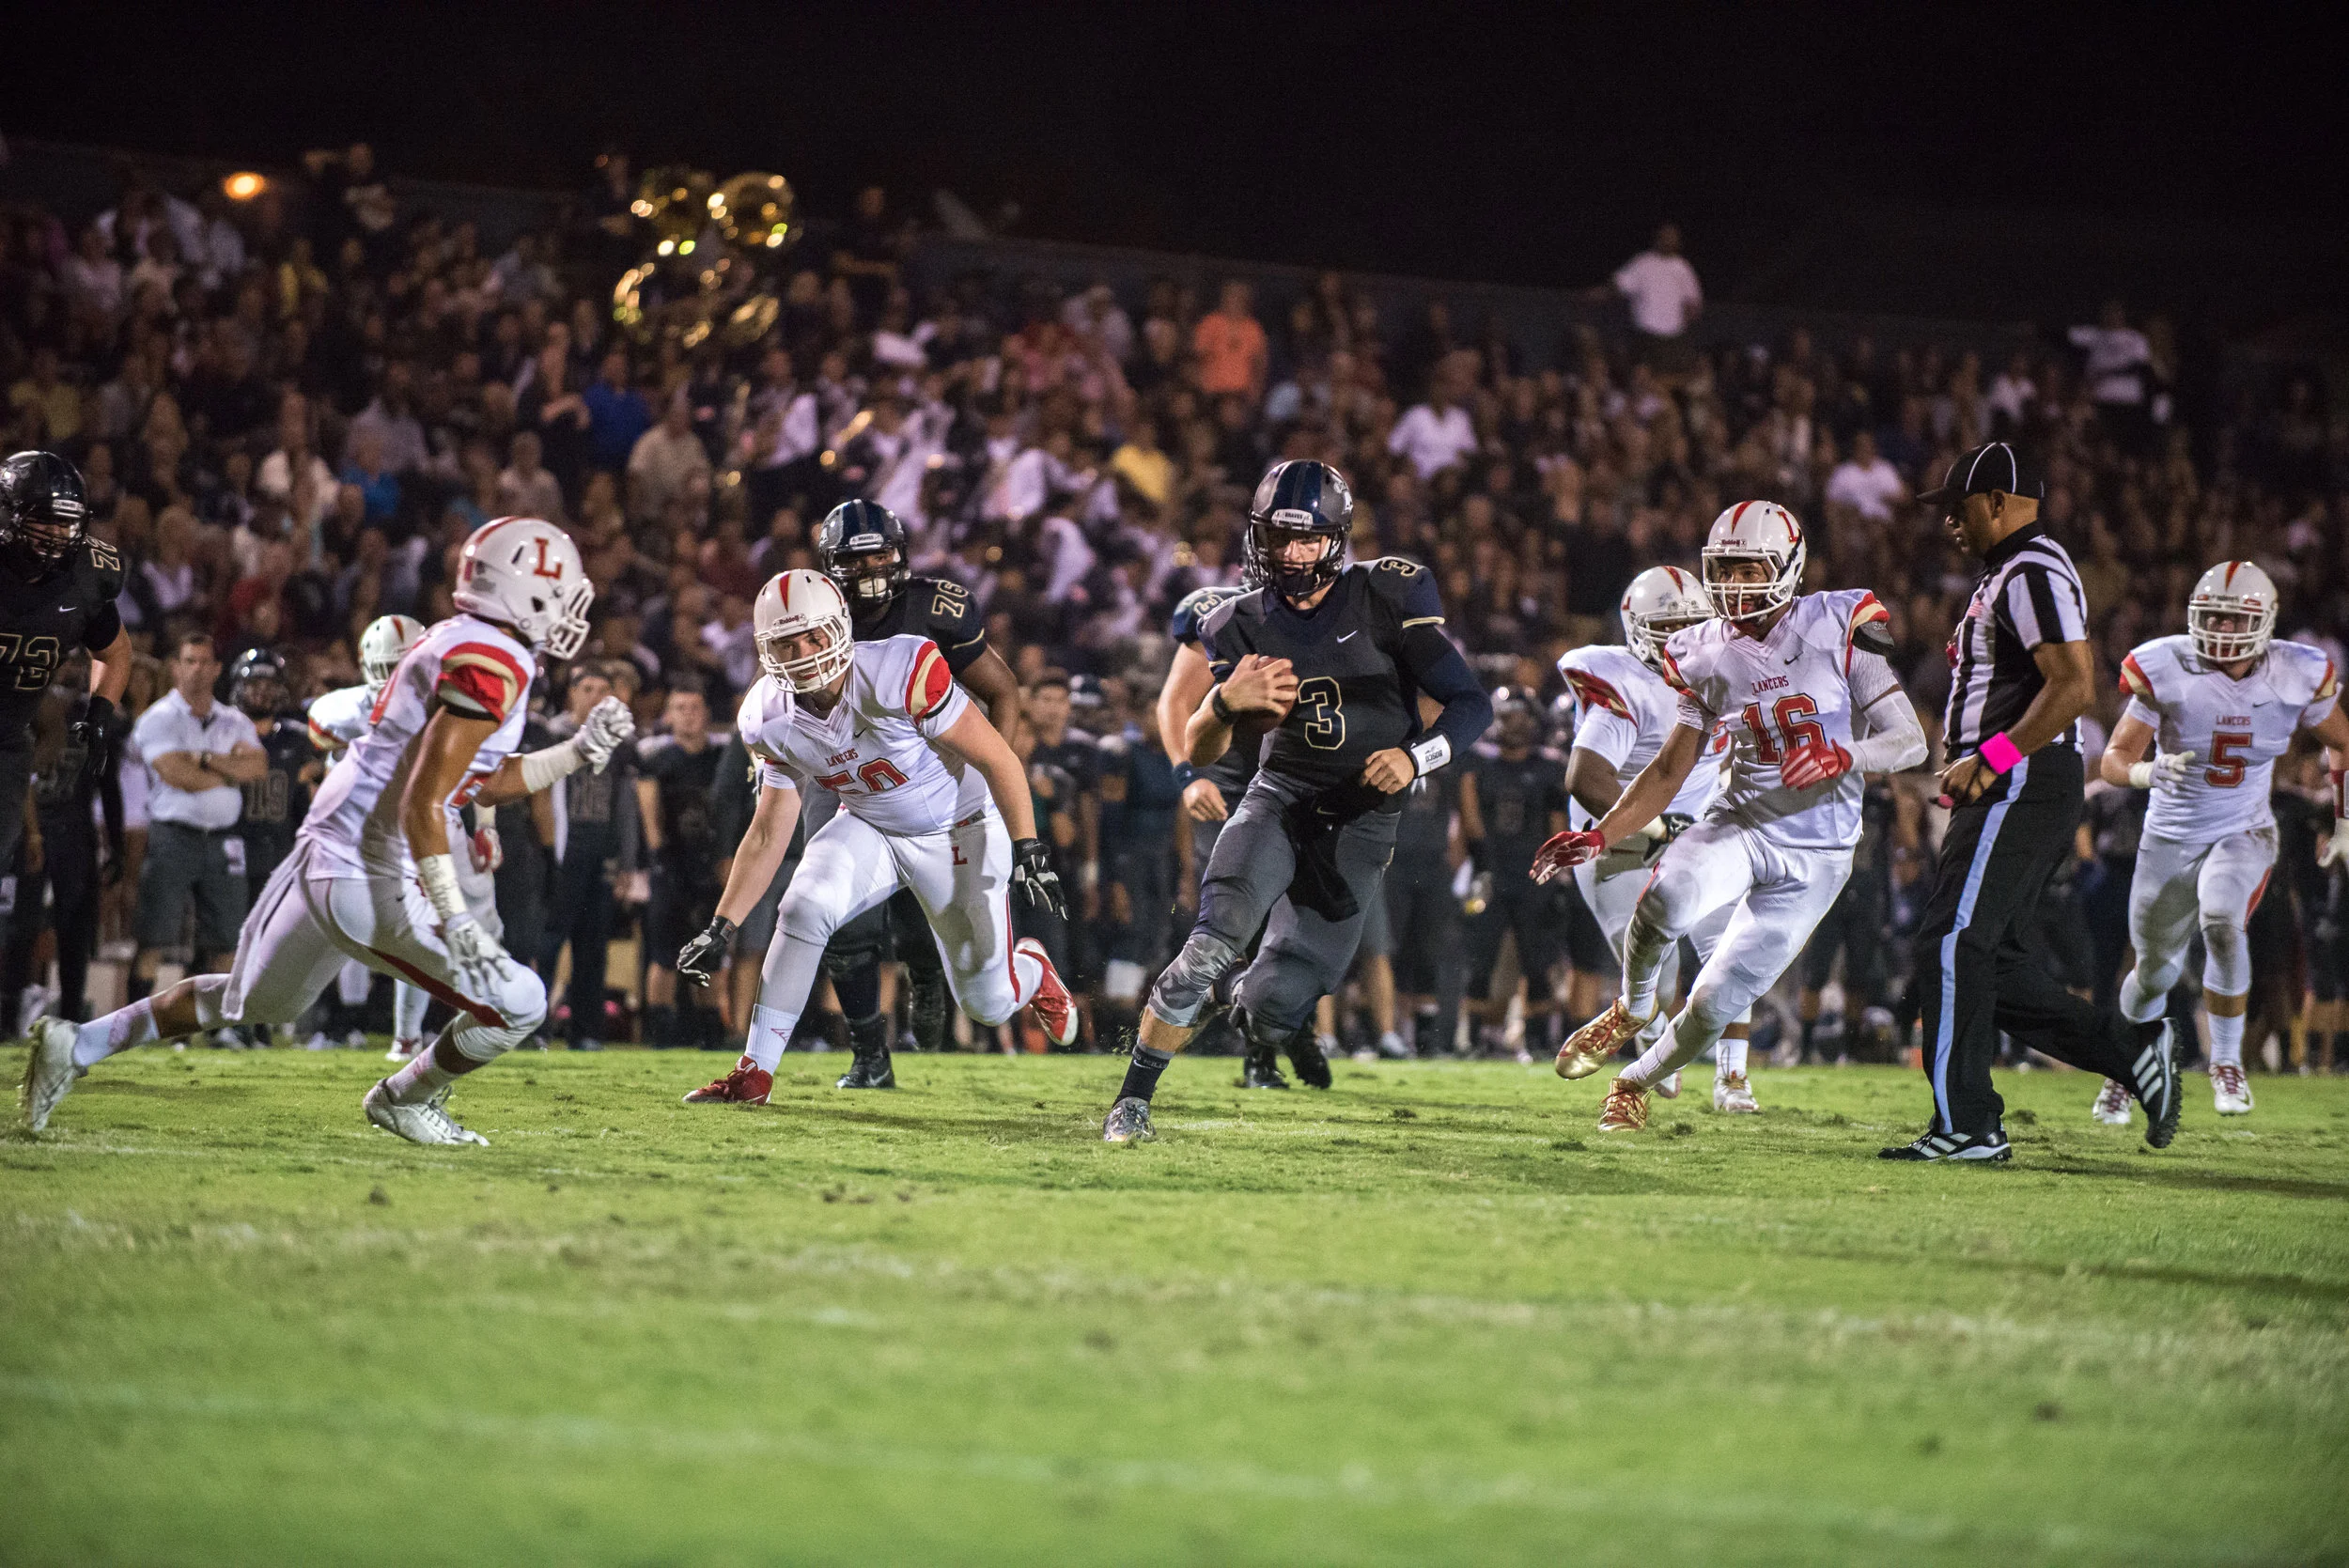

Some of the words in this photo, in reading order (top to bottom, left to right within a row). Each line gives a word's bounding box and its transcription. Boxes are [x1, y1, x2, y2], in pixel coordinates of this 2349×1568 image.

[533, 537, 563, 580] L
[1380, 559, 1419, 577] 3
[931, 580, 969, 618] 76
[779, 614, 801, 626] Riddell
[1751, 675, 1789, 694] LANCERS
[1298, 675, 1346, 750] 3
[2216, 715, 2251, 726] LANCERS
[1741, 692, 1827, 766] 16
[825, 748, 859, 767] LANCERS
[2203, 731, 2253, 788] 5
[951, 846, 968, 865] L
